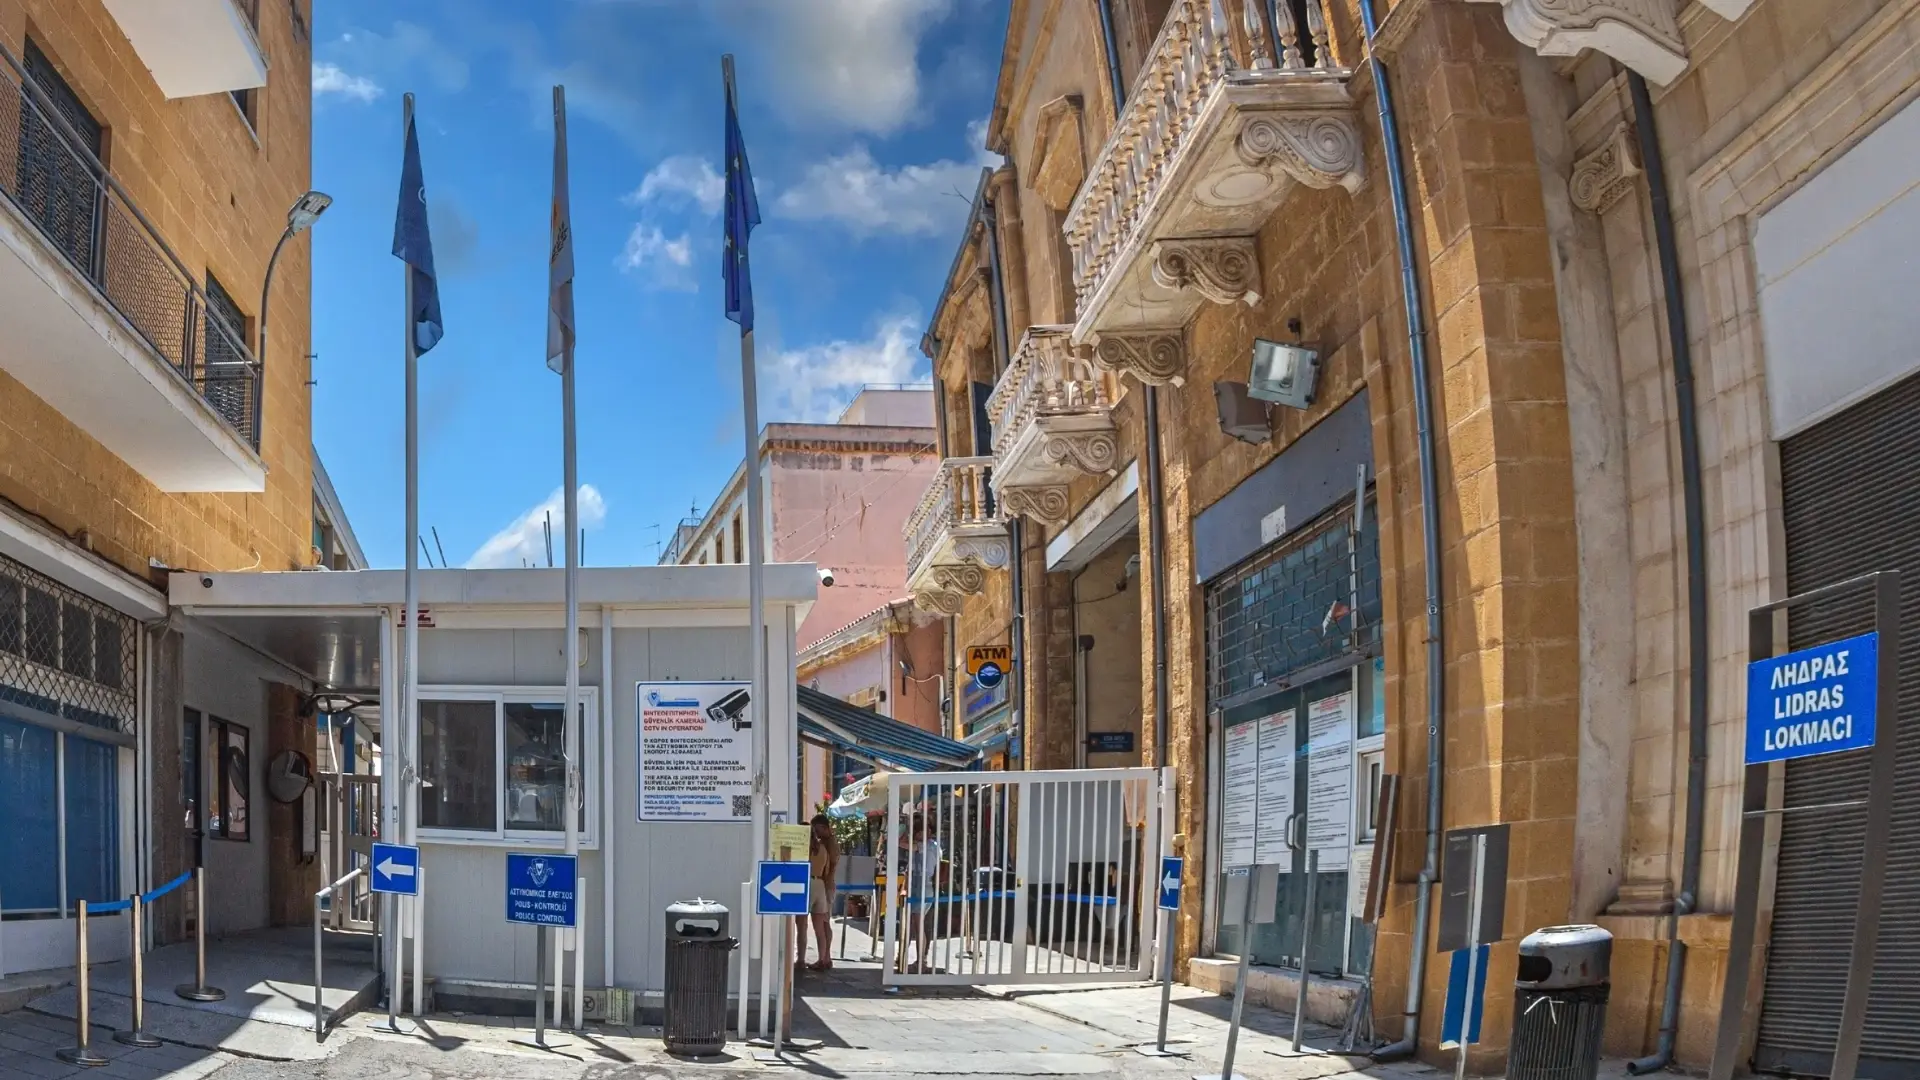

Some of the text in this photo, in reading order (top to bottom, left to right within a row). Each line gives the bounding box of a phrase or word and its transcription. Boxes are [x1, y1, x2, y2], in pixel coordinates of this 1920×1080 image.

[972, 647, 1007, 660] ATM
[1770, 650, 1849, 690] ΛΗΔΡΑΣ
[1774, 684, 1844, 720] LIDRAS
[1764, 715, 1852, 751] LOKMACI
[548, 890, 573, 900] ΕΛΕΓΧΟΣ
[515, 912, 566, 924] POLICE CONTROL
